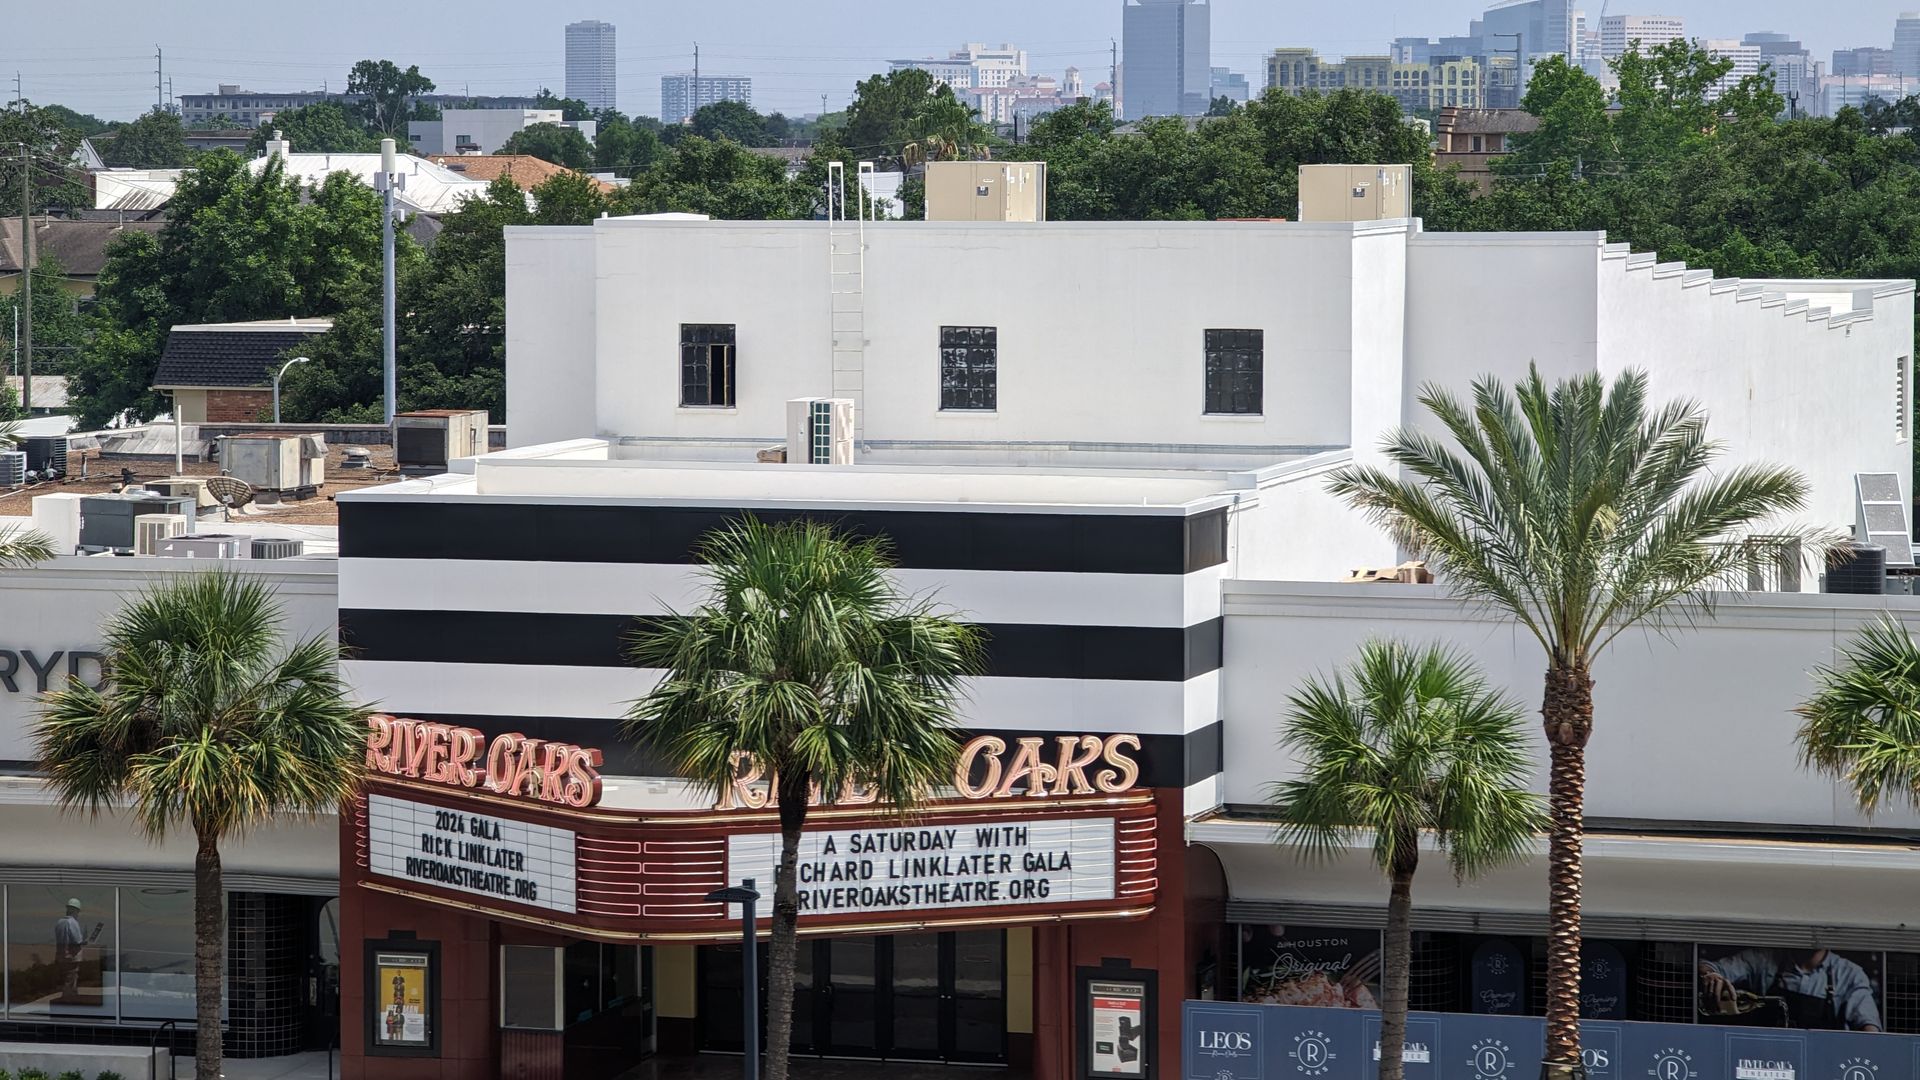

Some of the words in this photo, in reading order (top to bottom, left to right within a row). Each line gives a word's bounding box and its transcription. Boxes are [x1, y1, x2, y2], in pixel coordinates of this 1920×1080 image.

[366, 714, 486, 788] RIVER
[487, 732, 604, 808] OAKS
[953, 733, 1142, 799] OAKS
[435, 810, 464, 834] 2024
[470, 817, 501, 842] GALA
[823, 834, 838, 855] A
[850, 828, 957, 854] SATURDAY
[975, 826, 1028, 848] WITH
[421, 833, 453, 859] RICK
[458, 840, 524, 872] LINKLATER
[406, 856, 537, 901] RIVEROAKSTHEATRE.ORG
[774, 858, 873, 886] CHARD
[889, 853, 1011, 880] LINKLATER
[1023, 850, 1071, 873] GALA
[798, 878, 1050, 911] RIVEROAKSTHEATRE.ORG
[1288, 938, 1349, 949] HOUSTON
[1272, 952, 1352, 983] Original
[1294, 1029, 1331, 1044] RIVER
[1471, 1038, 1510, 1052] RIVER
[1307, 1043, 1318, 1062] R
[1485, 1051, 1496, 1071] R
[1653, 1047, 1692, 1062] RIVER
[1839, 1057, 1879, 1071] RIVER
[1296, 1065, 1329, 1076] OAKS
